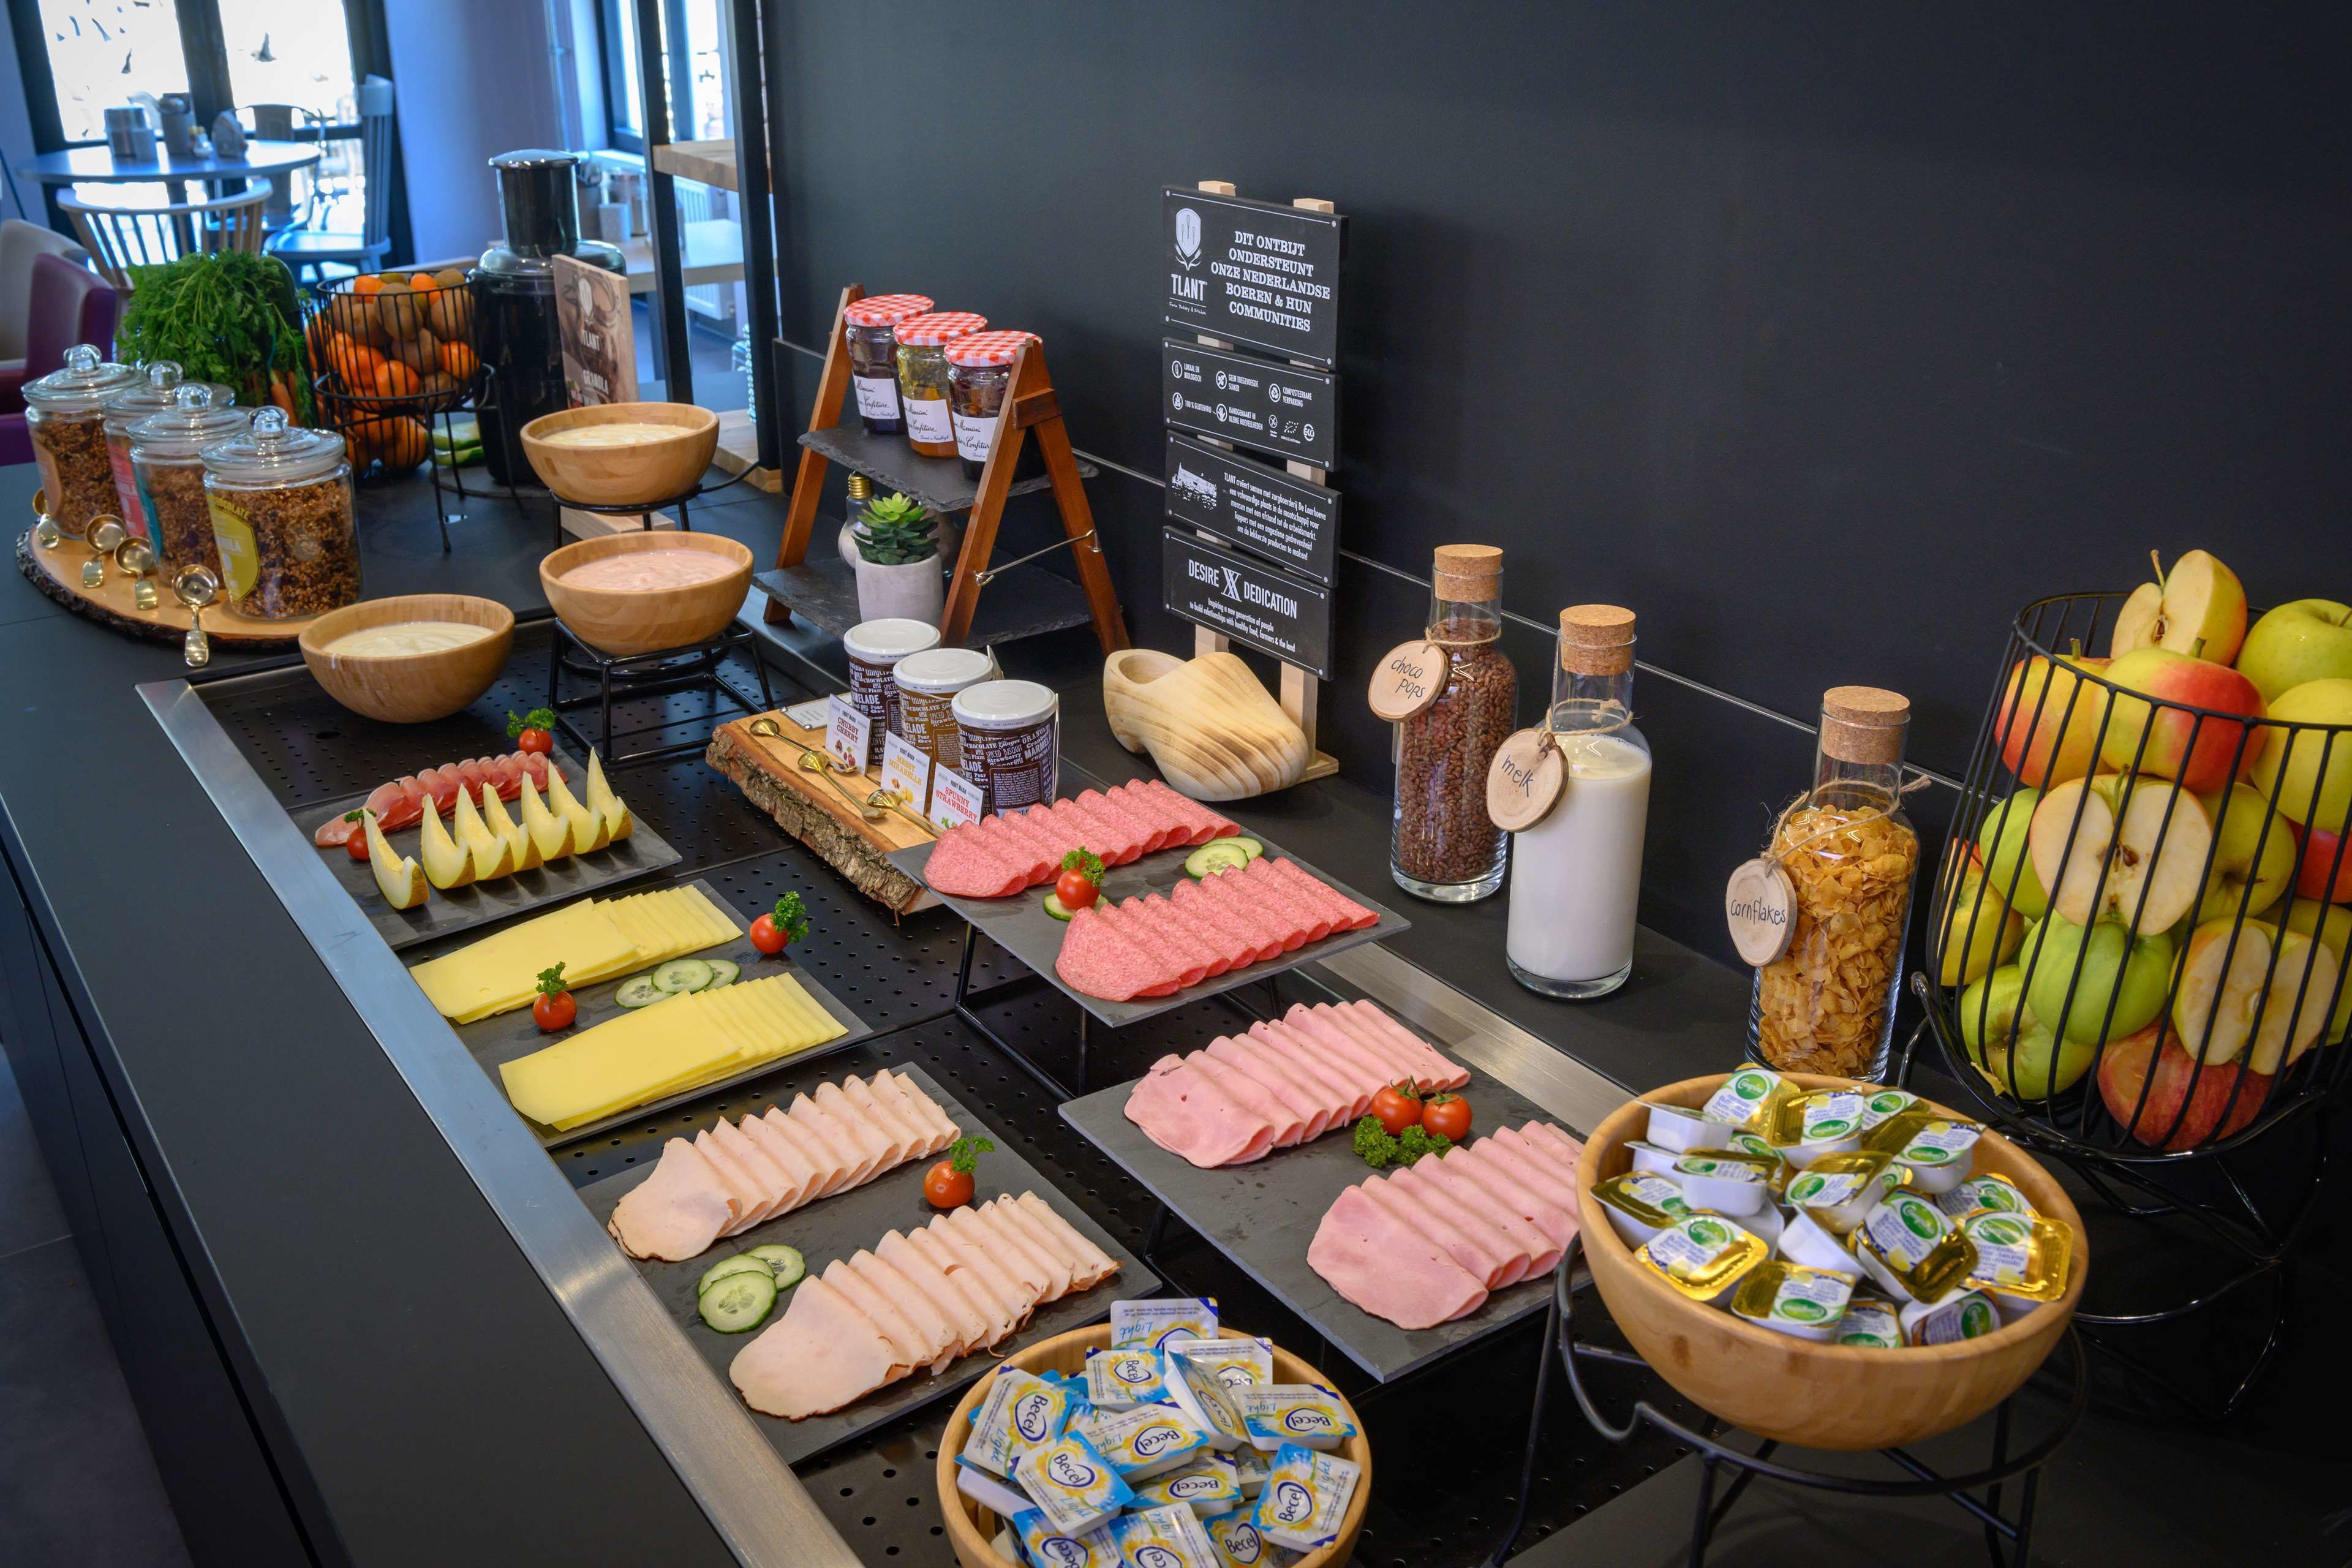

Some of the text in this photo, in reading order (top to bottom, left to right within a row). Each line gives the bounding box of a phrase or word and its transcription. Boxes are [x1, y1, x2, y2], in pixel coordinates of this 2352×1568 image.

[1235, 231, 1305, 256] DIT ONTBIJT
[1229, 247, 1313, 277] ONDERSTEUNT
[1211, 262, 1330, 300] ONZE NEDERLANDSE
[1226, 282, 1312, 314] BOEREN & HUN
[1229, 301, 1310, 332] COMMUNITIES
[583, 369, 609, 395] GRANOLA
[1228, 374, 1259, 388] GEEN TOEGEVOEGDE
[1228, 383, 1240, 392] SUIKER
[1283, 386, 1312, 401] COMPOSTEERBARE
[1283, 396, 1303, 407] VERPAKKING
[1229, 406, 1251, 419] HANDGEMAAKT
[1229, 415, 1263, 431] KLEINE HOEVEELHEDEN
[966, 436, 990, 451] Confitur
[1224, 472, 1236, 484] TLANT
[1250, 484, 1262, 495] samen
[1272, 494, 1298, 511] zorgboerderij
[1298, 502, 1304, 511] De
[1305, 504, 1326, 521] Laarhoeve
[1231, 500, 1245, 511] mensen
[1262, 511, 1276, 524] afstand
[1283, 519, 1288, 529] de
[1237, 490, 1260, 507] volwaardige
[1260, 499, 1272, 511] plaats
[1273, 503, 1276, 512] in
[1278, 505, 1283, 514] de
[1283, 510, 1309, 527] maatschappij
[1310, 521, 1319, 530] voor
[1234, 511, 1248, 524] Toppers
[1265, 526, 1284, 539] ongeziene
[1285, 533, 1312, 551] gedrevenheid
[1244, 526, 1249, 535] de
[1250, 527, 1267, 543] lekkerste
[1267, 538, 1287, 552] producten
[1188, 559, 1219, 587] DESIRE
[1244, 581, 1297, 619] DEDICATION
[1235, 611, 1256, 625] generation
[1256, 617, 1261, 626] of
[1261, 622, 1274, 632] people
[1391, 656, 1423, 679] choco
[1395, 676, 1426, 699] pops
[837, 725, 858, 743] CHERRY
[838, 717, 859, 735] CHUBBY
[986, 744, 1022, 759] SPICED BISQUIT
[998, 739, 1020, 749] Ginger
[897, 755, 916, 772] MESSY
[987, 753, 1022, 763] Strawberry
[889, 758, 922, 786] MIRABELLE
[1501, 755, 1534, 797] melk
[936, 790, 978, 821] STRAWBERRY
[945, 786, 970, 807] SPUNNY
[1120, 1318, 1154, 1340] Light
[1126, 1360, 1142, 1380] Becel
[1022, 1395, 1049, 1434] Becel
[1245, 1401, 1277, 1414] Light
[1291, 1416, 1331, 1427] Becel
[990, 1428, 1008, 1464] Light
[1139, 1430, 1181, 1451] Becel
[1054, 1453, 1086, 1484] Becel
[1317, 1460, 1336, 1491] Light
[1176, 1480, 1219, 1492] Becel
[1278, 1488, 1303, 1522] Becel
[1225, 1532, 1258, 1554] Becel
